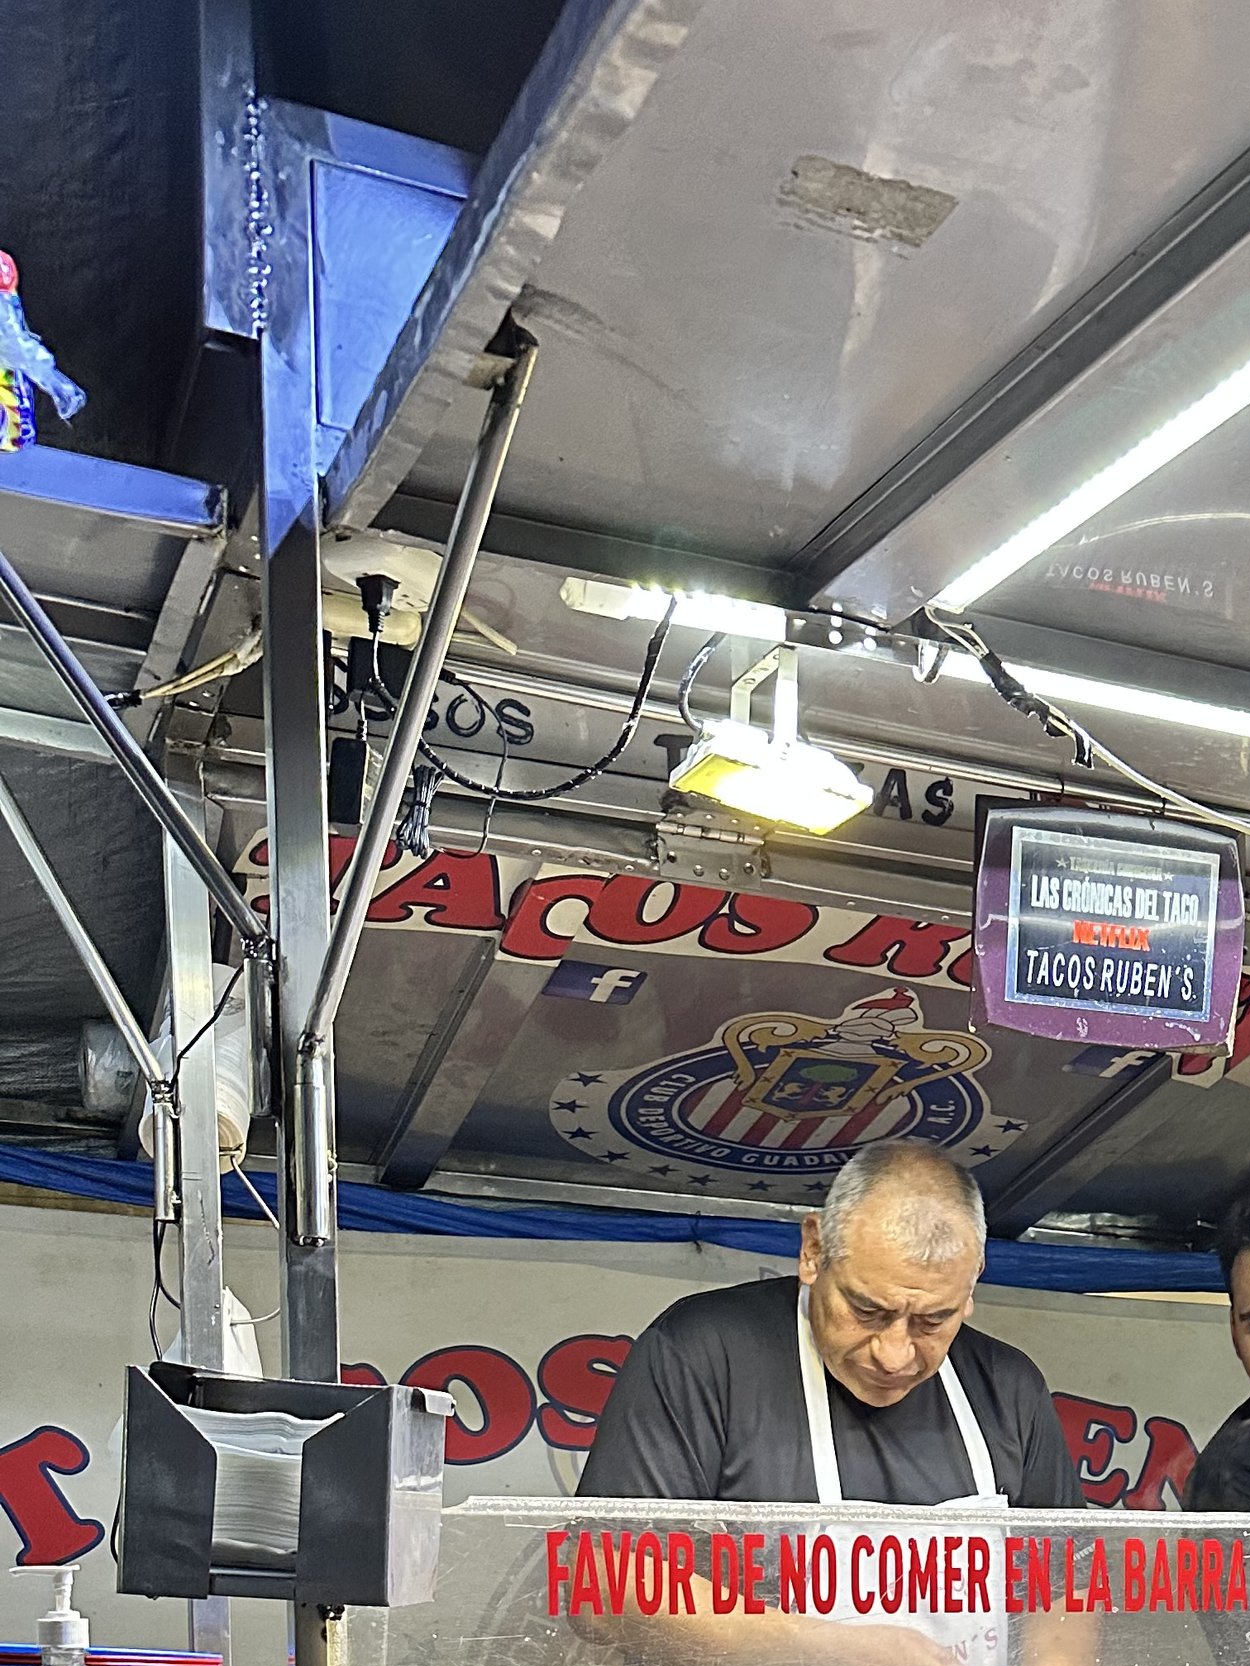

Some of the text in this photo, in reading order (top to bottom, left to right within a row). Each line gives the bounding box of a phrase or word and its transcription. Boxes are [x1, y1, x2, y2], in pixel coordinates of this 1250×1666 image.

[1031, 875, 1060, 909] LAS
[1063, 877, 1132, 918] CRÓNICAS
[1135, 889, 1160, 921] DEL
[1072, 920, 1151, 951] NETFLIX
[1026, 950, 1096, 990] TACOS
[643, 1072, 696, 1102] CLUB
[638, 1106, 731, 1160] DEPORTIVO
[547, 1530, 1249, 1617] FAVOR DE NO COMER EN LA BARRA
